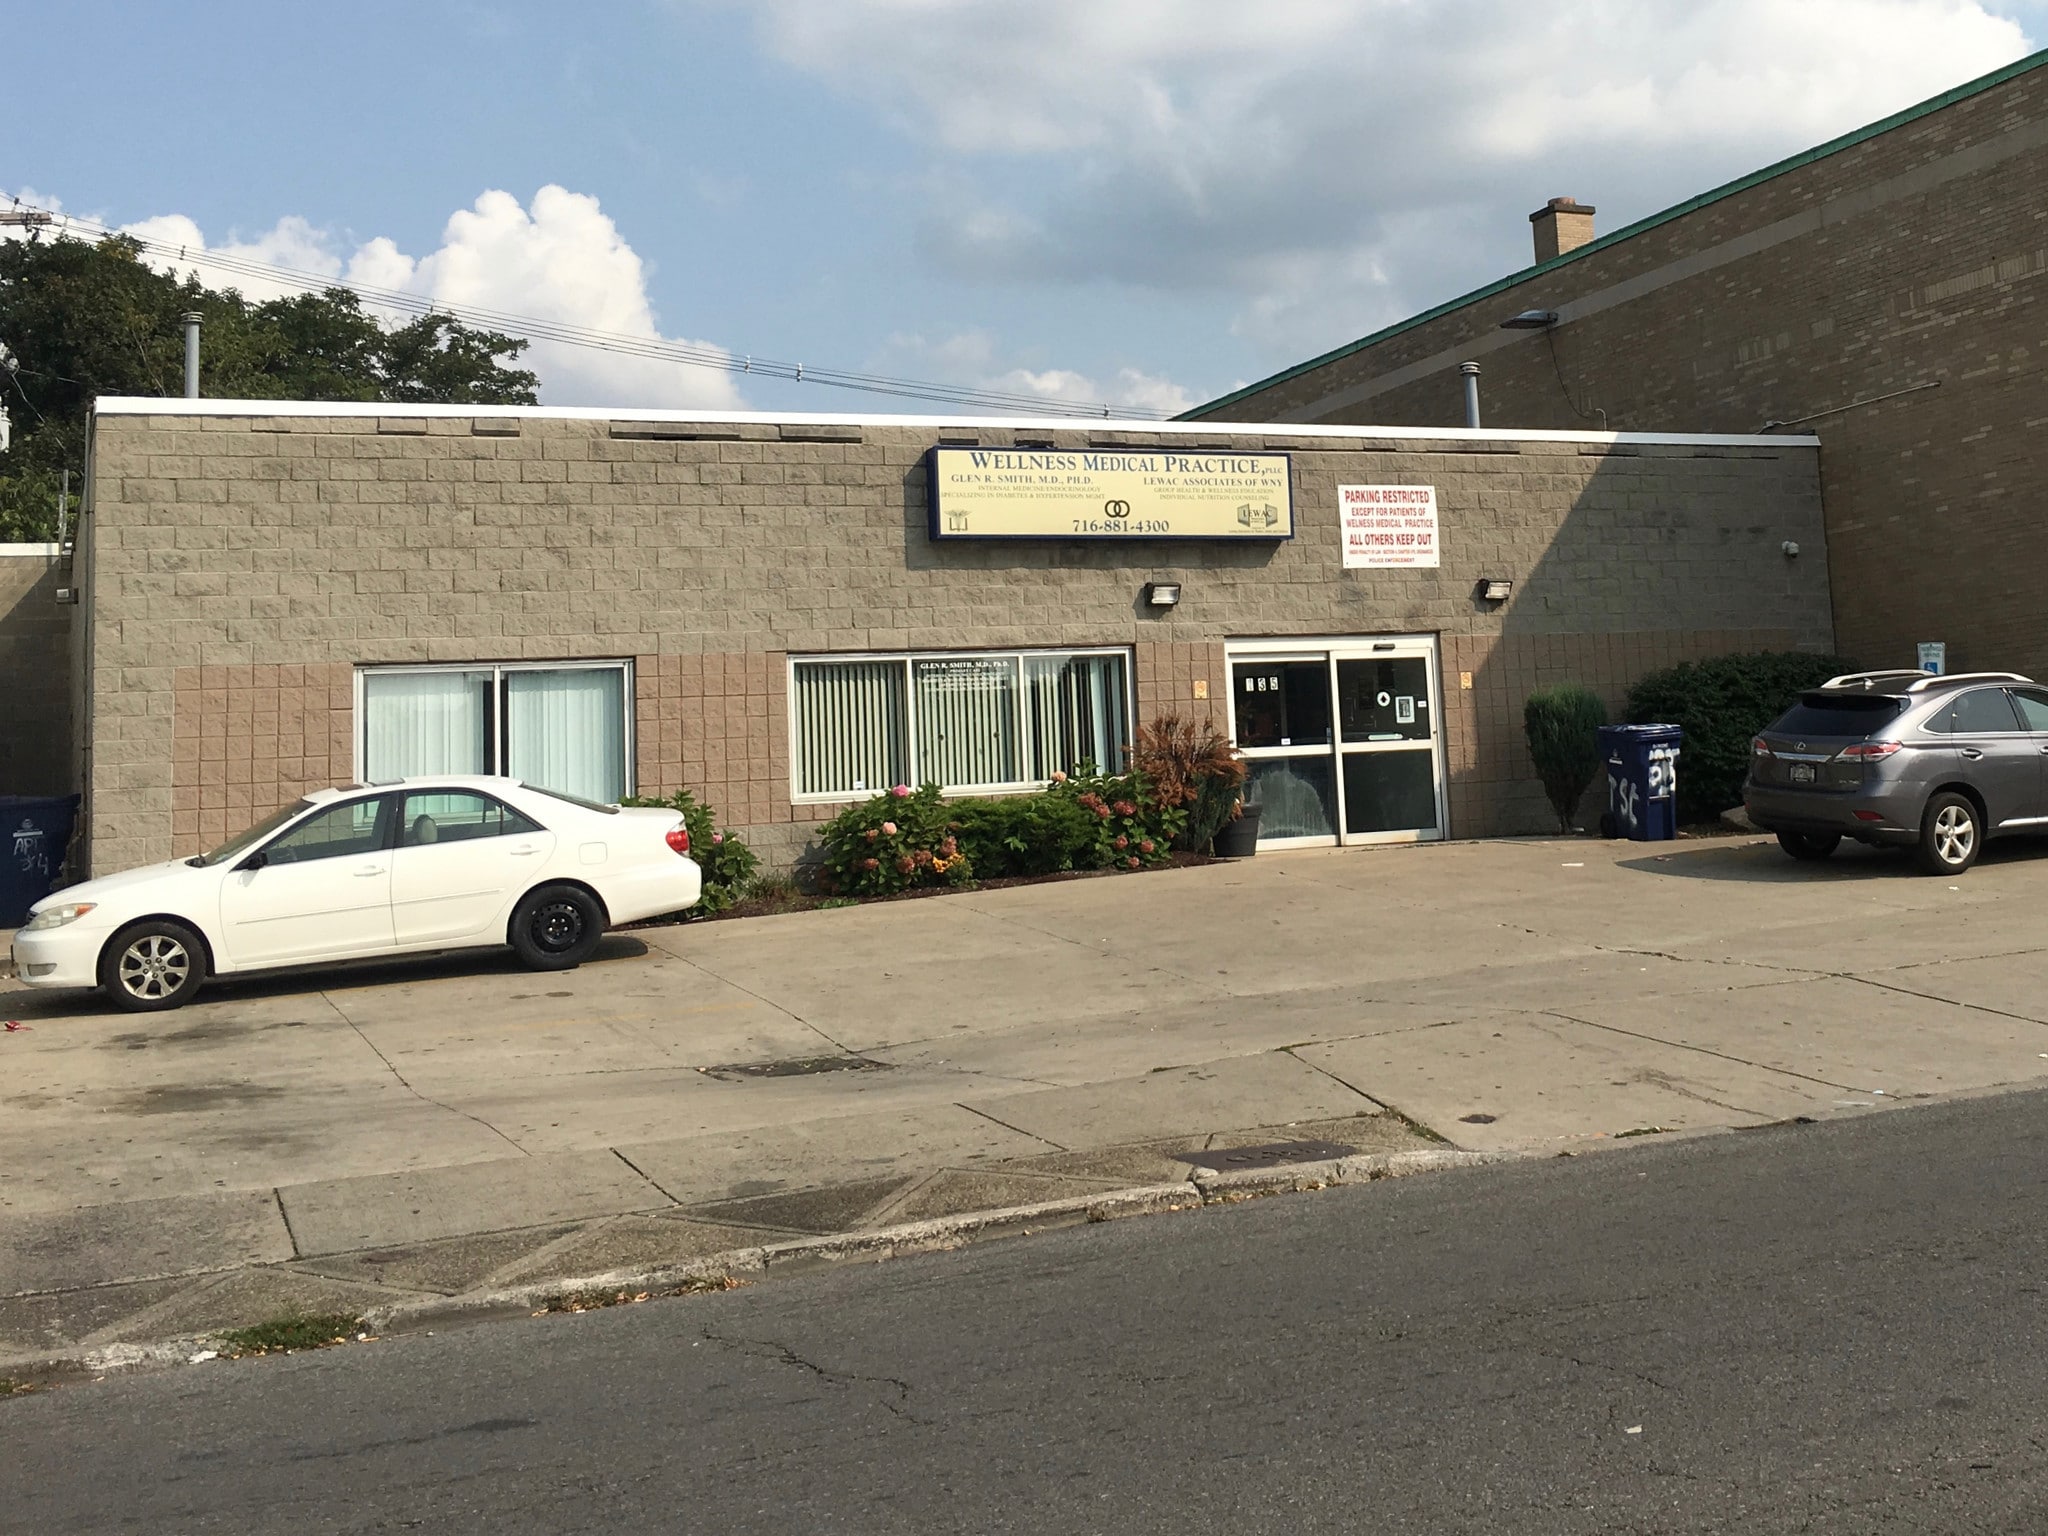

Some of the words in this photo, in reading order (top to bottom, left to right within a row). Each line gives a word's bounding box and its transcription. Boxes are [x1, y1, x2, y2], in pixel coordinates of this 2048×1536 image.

[970, 452, 1076, 470] WELLNESS
[1083, 454, 1159, 472] MEDICAL
[951, 474, 980, 483] GLEN
[984, 474, 994, 483] R.
[1143, 477, 1179, 486] LEWAC
[1182, 478, 1242, 487] ASSOCIATES
[1245, 479, 1258, 487] OF
[1261, 479, 1284, 487] WNY
[1345, 490, 1380, 503] PARKING
[1382, 490, 1430, 503] RESTRICTED
[1351, 507, 1374, 516] EXCEPT
[1376, 507, 1388, 516] FOR
[1389, 507, 1417, 516] PATIENTS
[1418, 508, 1426, 516] OF
[1072, 519, 1169, 533] 716-881-4300
[1376, 519, 1402, 528] MEDICAL
[1405, 519, 1434, 528] PRACTICE
[1349, 534, 1363, 545] ALL
[1365, 534, 1394, 545] OTHERS
[1396, 534, 1415, 545] KEEP
[1417, 534, 1432, 545] OUT
